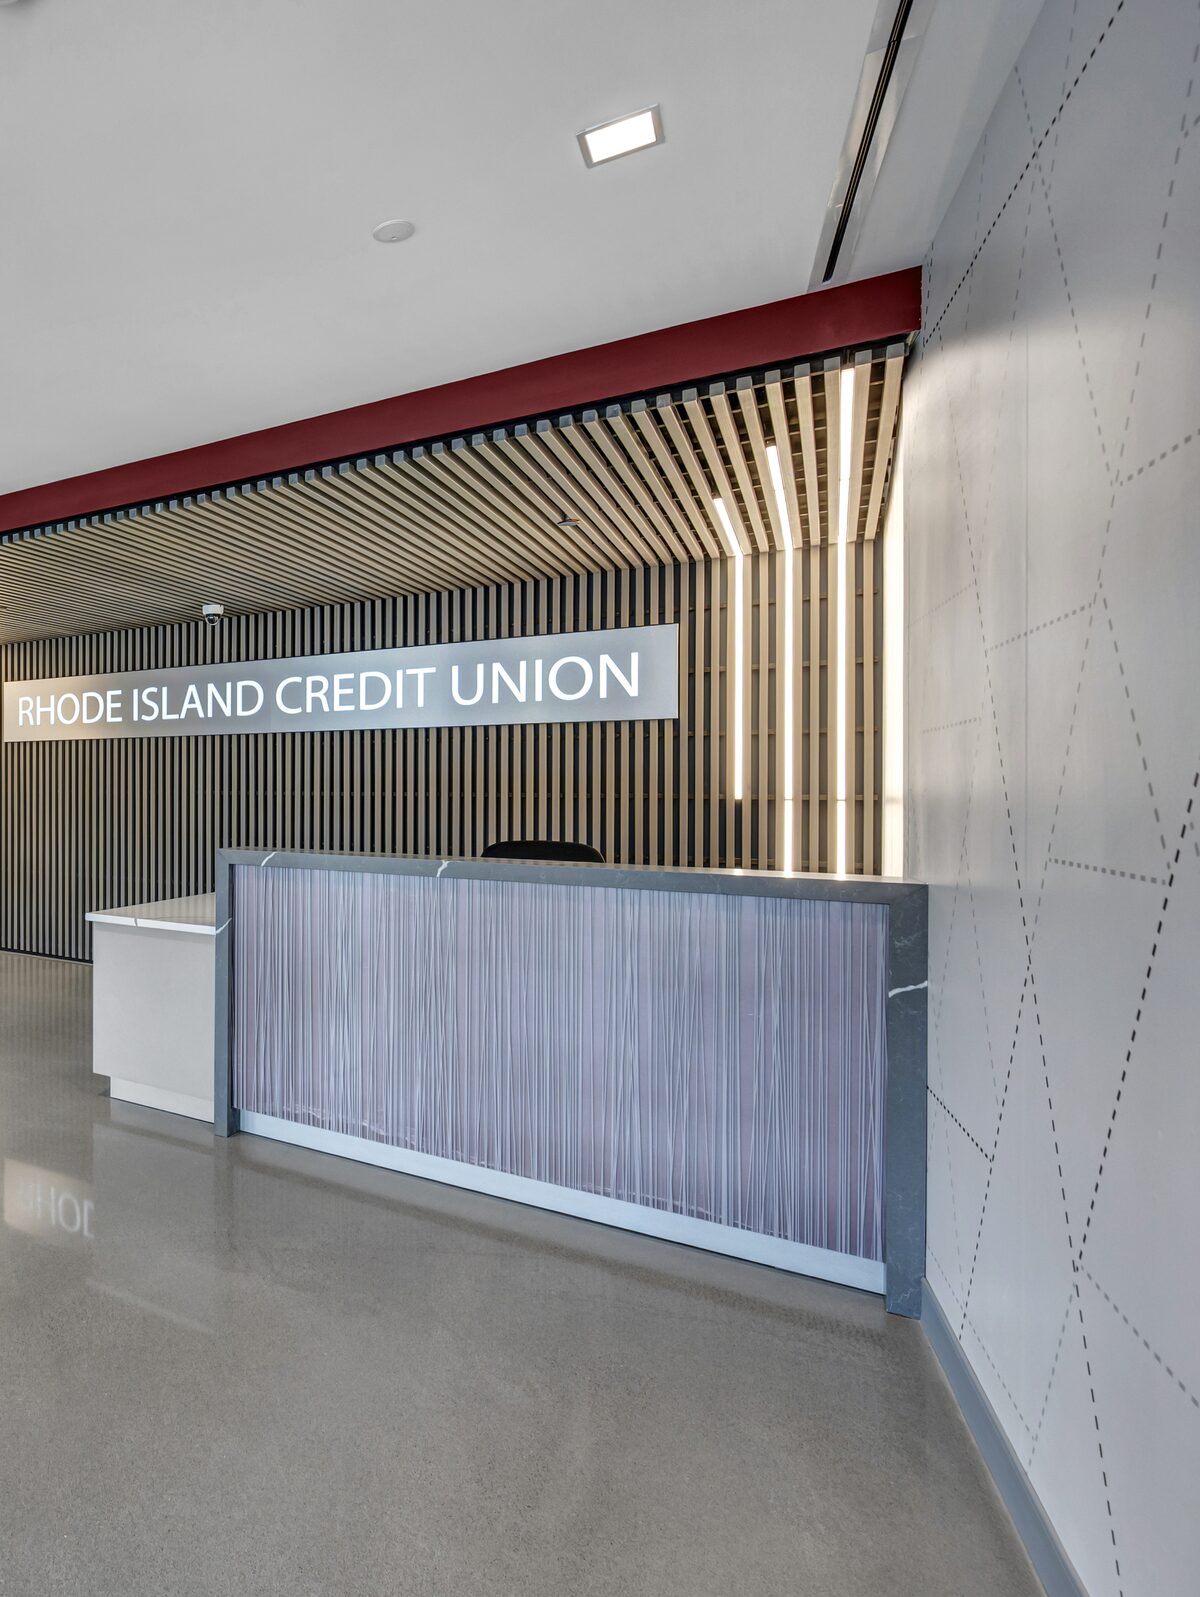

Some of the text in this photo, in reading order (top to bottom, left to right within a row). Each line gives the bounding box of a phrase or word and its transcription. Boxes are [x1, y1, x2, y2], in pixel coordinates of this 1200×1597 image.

[18, 651, 639, 727] RHODE ISLAND CREDIT UNION
